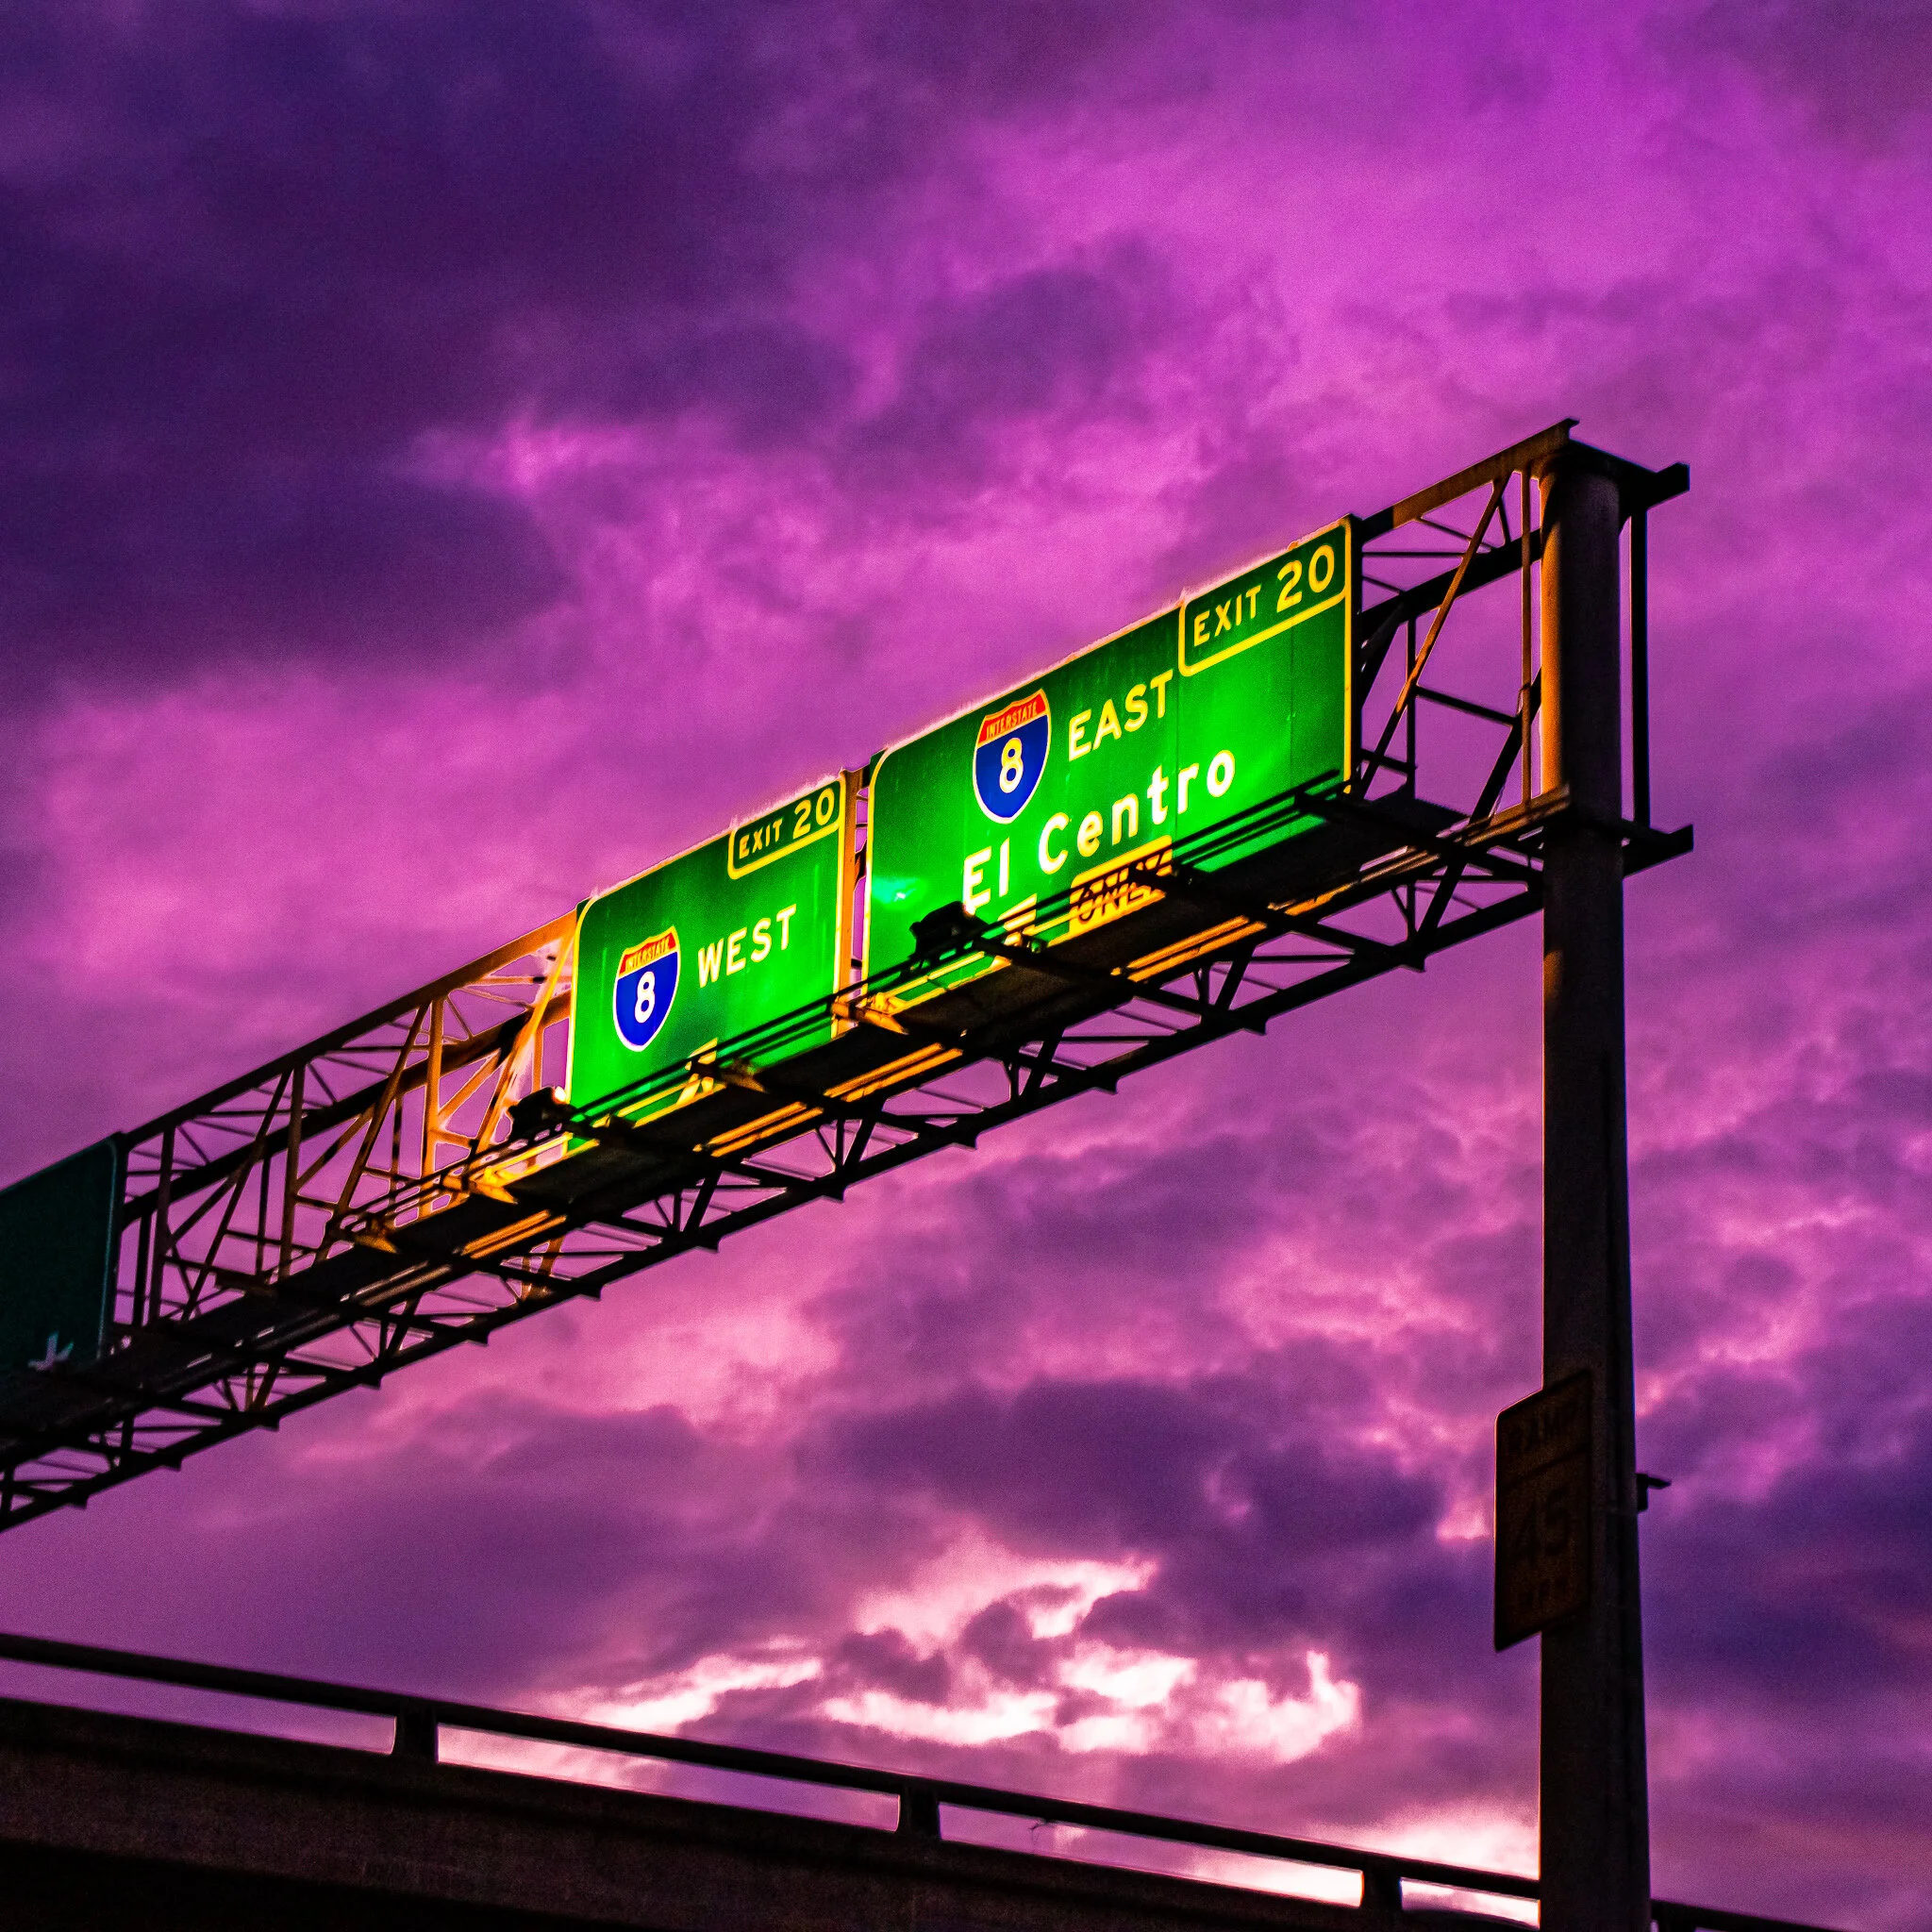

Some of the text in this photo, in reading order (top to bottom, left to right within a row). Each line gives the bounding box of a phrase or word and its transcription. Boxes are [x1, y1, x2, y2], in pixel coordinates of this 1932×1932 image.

[1193, 544, 1335, 647] EXIT 20
[986, 701, 1038, 741] INTERSTATE
[1068, 669, 1174, 761] EAST
[999, 738, 1024, 793] 8
[739, 787, 835, 859] EXIT 20
[963, 750, 1236, 913] El Centro
[625, 936, 670, 972] INTERSTATE
[697, 904, 797, 989] WEST
[634, 971, 656, 1024] 8
